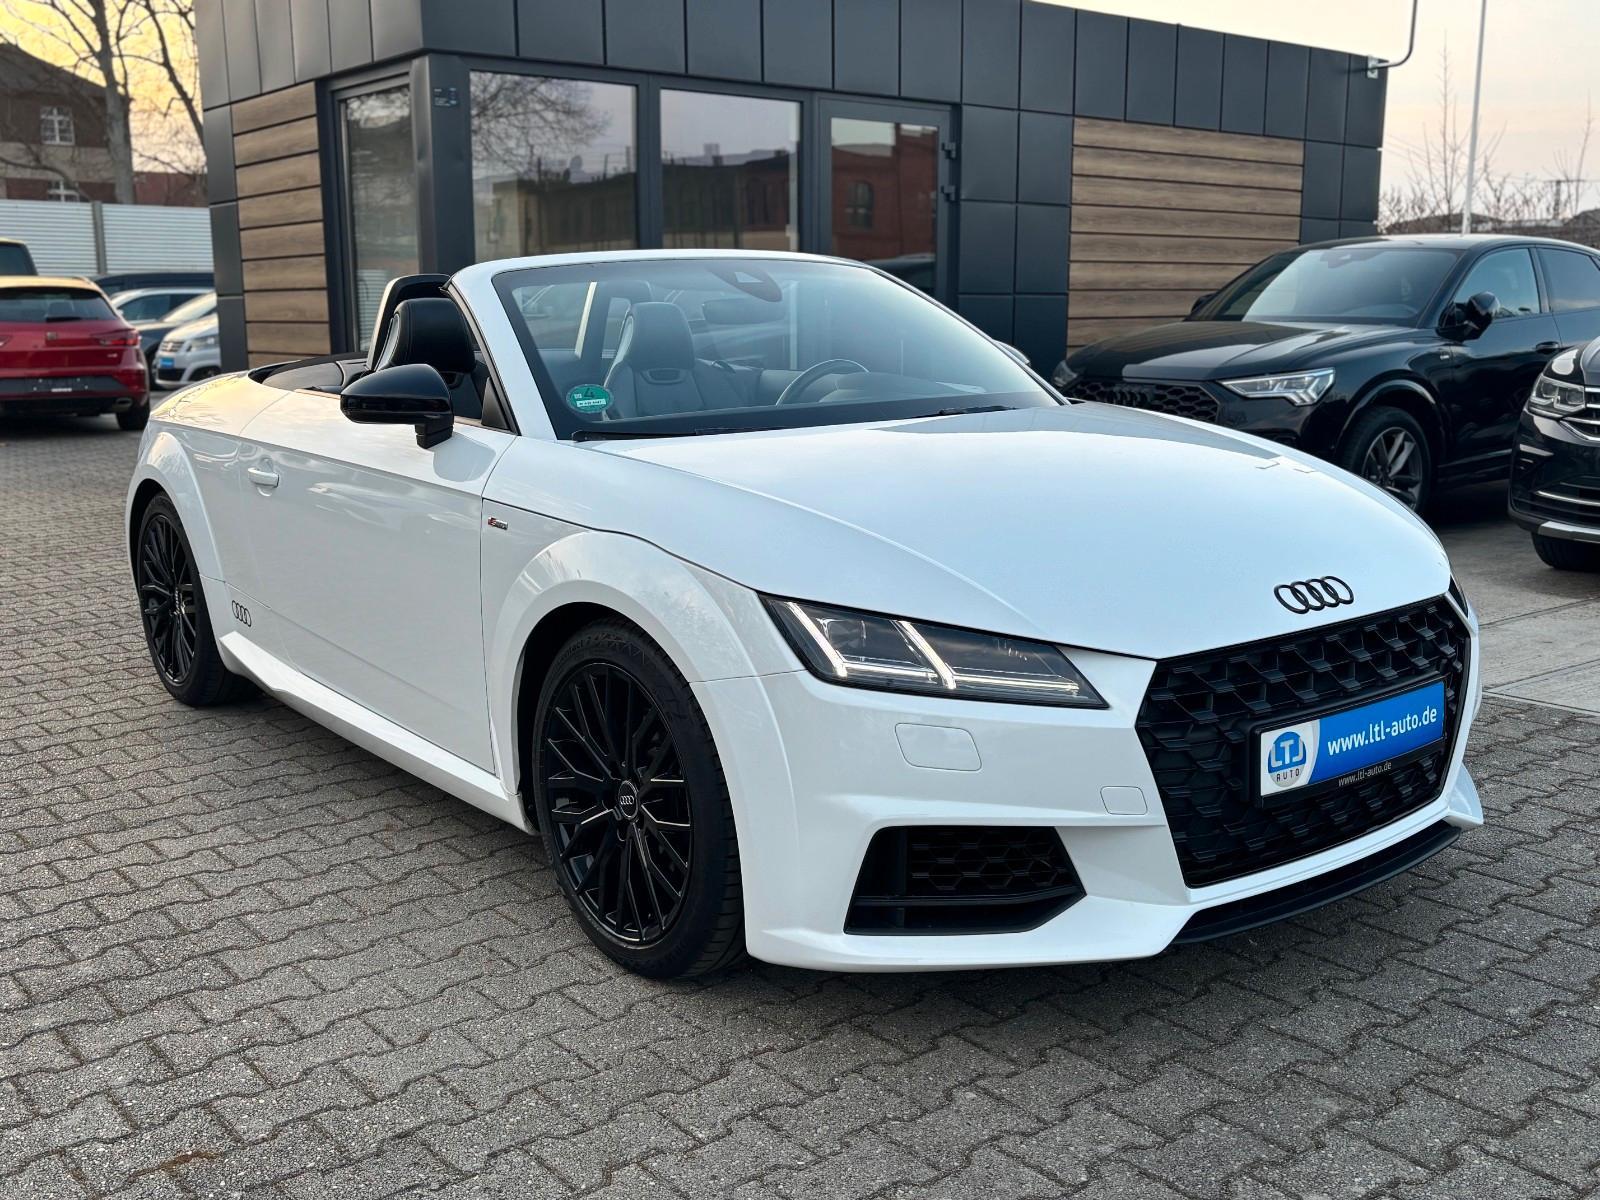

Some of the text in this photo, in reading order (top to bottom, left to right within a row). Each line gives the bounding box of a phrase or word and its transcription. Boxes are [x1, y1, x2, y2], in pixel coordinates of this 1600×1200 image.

[584, 387, 595, 398] 4
[1327, 705, 1438, 756] www.ltl-auto.de
[1276, 768, 1301, 782] AUTO
[1338, 761, 1392, 787] www.ltl-auto.de
